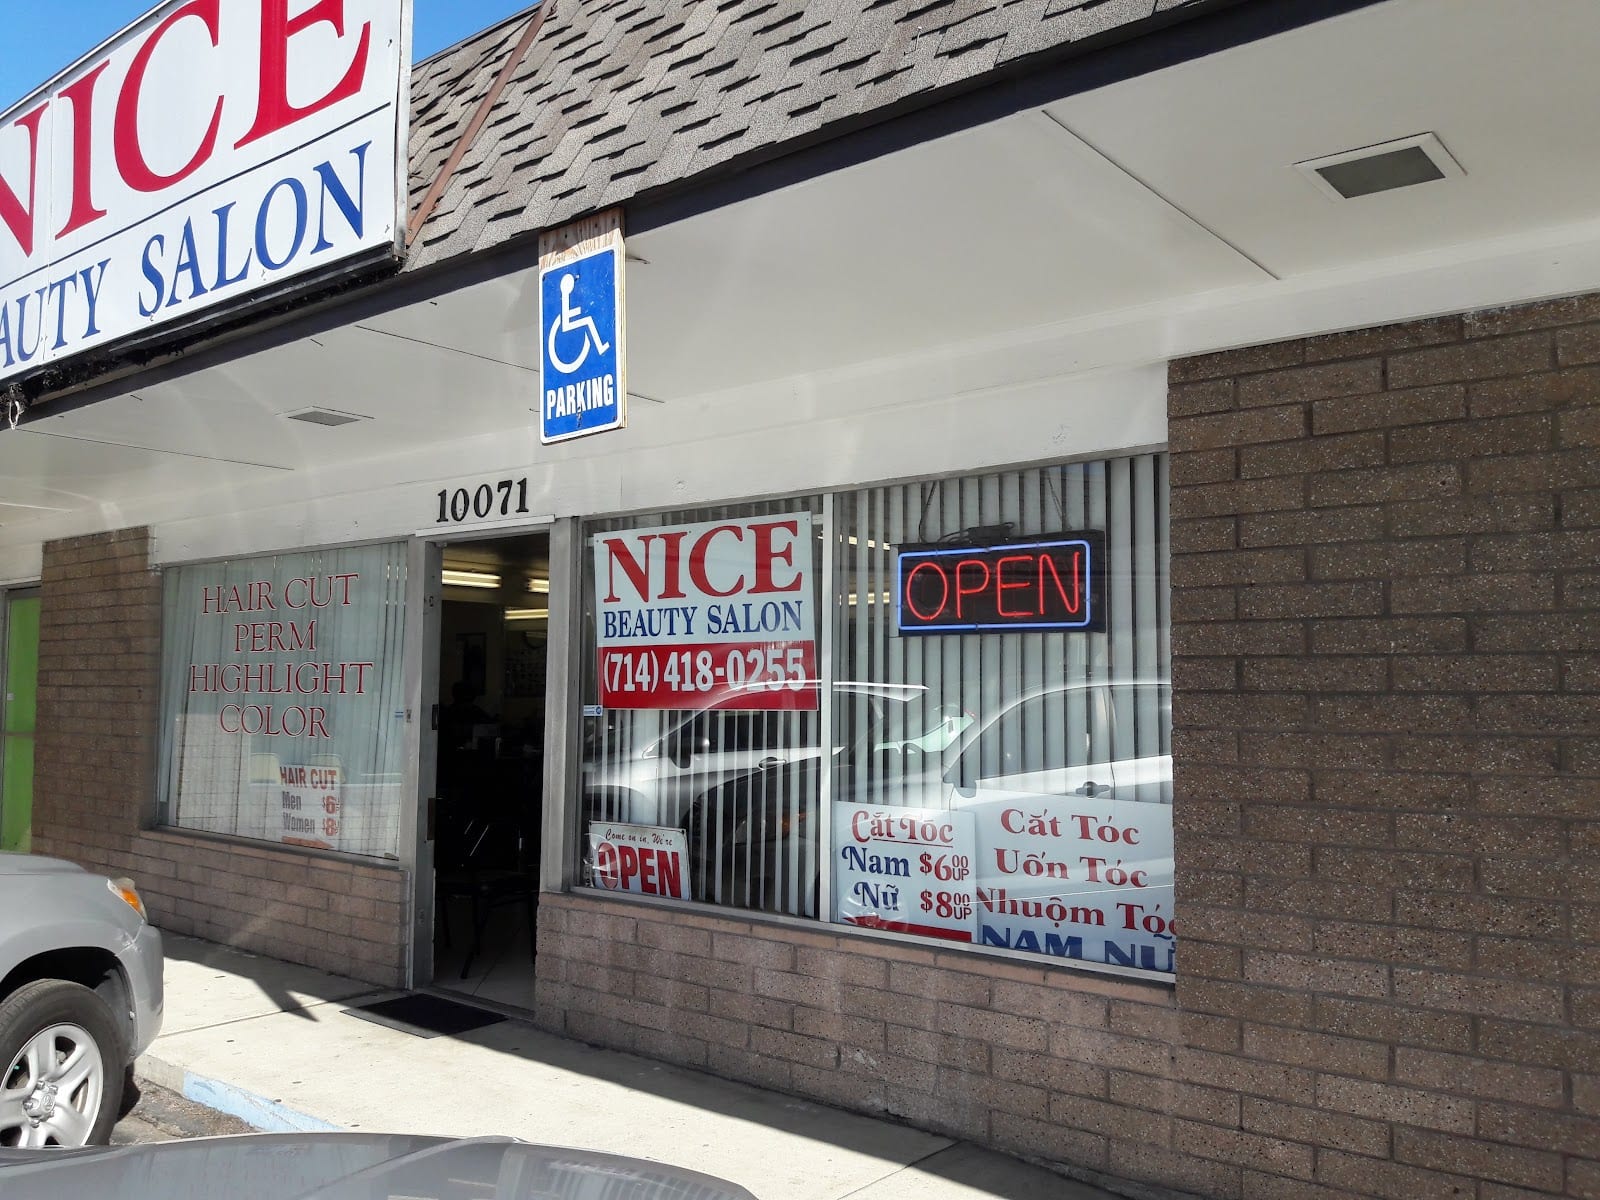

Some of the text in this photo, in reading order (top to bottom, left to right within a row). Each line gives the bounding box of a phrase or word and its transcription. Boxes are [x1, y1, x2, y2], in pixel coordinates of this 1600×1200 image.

[139, 140, 372, 318] SALON
[547, 374, 614, 420] PARKING
[436, 477, 530, 522] 10071
[603, 520, 803, 603] NICE
[202, 573, 359, 614] HAIR CUT
[906, 551, 1080, 621] OPEN
[234, 620, 316, 652] PERM
[604, 600, 803, 638] BEAUTY SALON
[189, 662, 373, 694] HIGHLIGHT
[604, 648, 806, 693] (714) 418-0255
[219, 704, 330, 738] COLOR
[280, 766, 337, 790] HAIR CUT
[282, 791, 302, 810] Men
[283, 812, 316, 834] Women
[605, 828, 625, 841] Come
[1001, 808, 1140, 845] Cắt Tóc
[598, 842, 682, 898] OPEN
[841, 845, 911, 878] Nam
[952, 868, 970, 881] UP
[994, 848, 1148, 888] Uốn Tóc
[853, 881, 900, 912] Nữ
[953, 906, 972, 920] UP
[982, 924, 1083, 961] NAM
